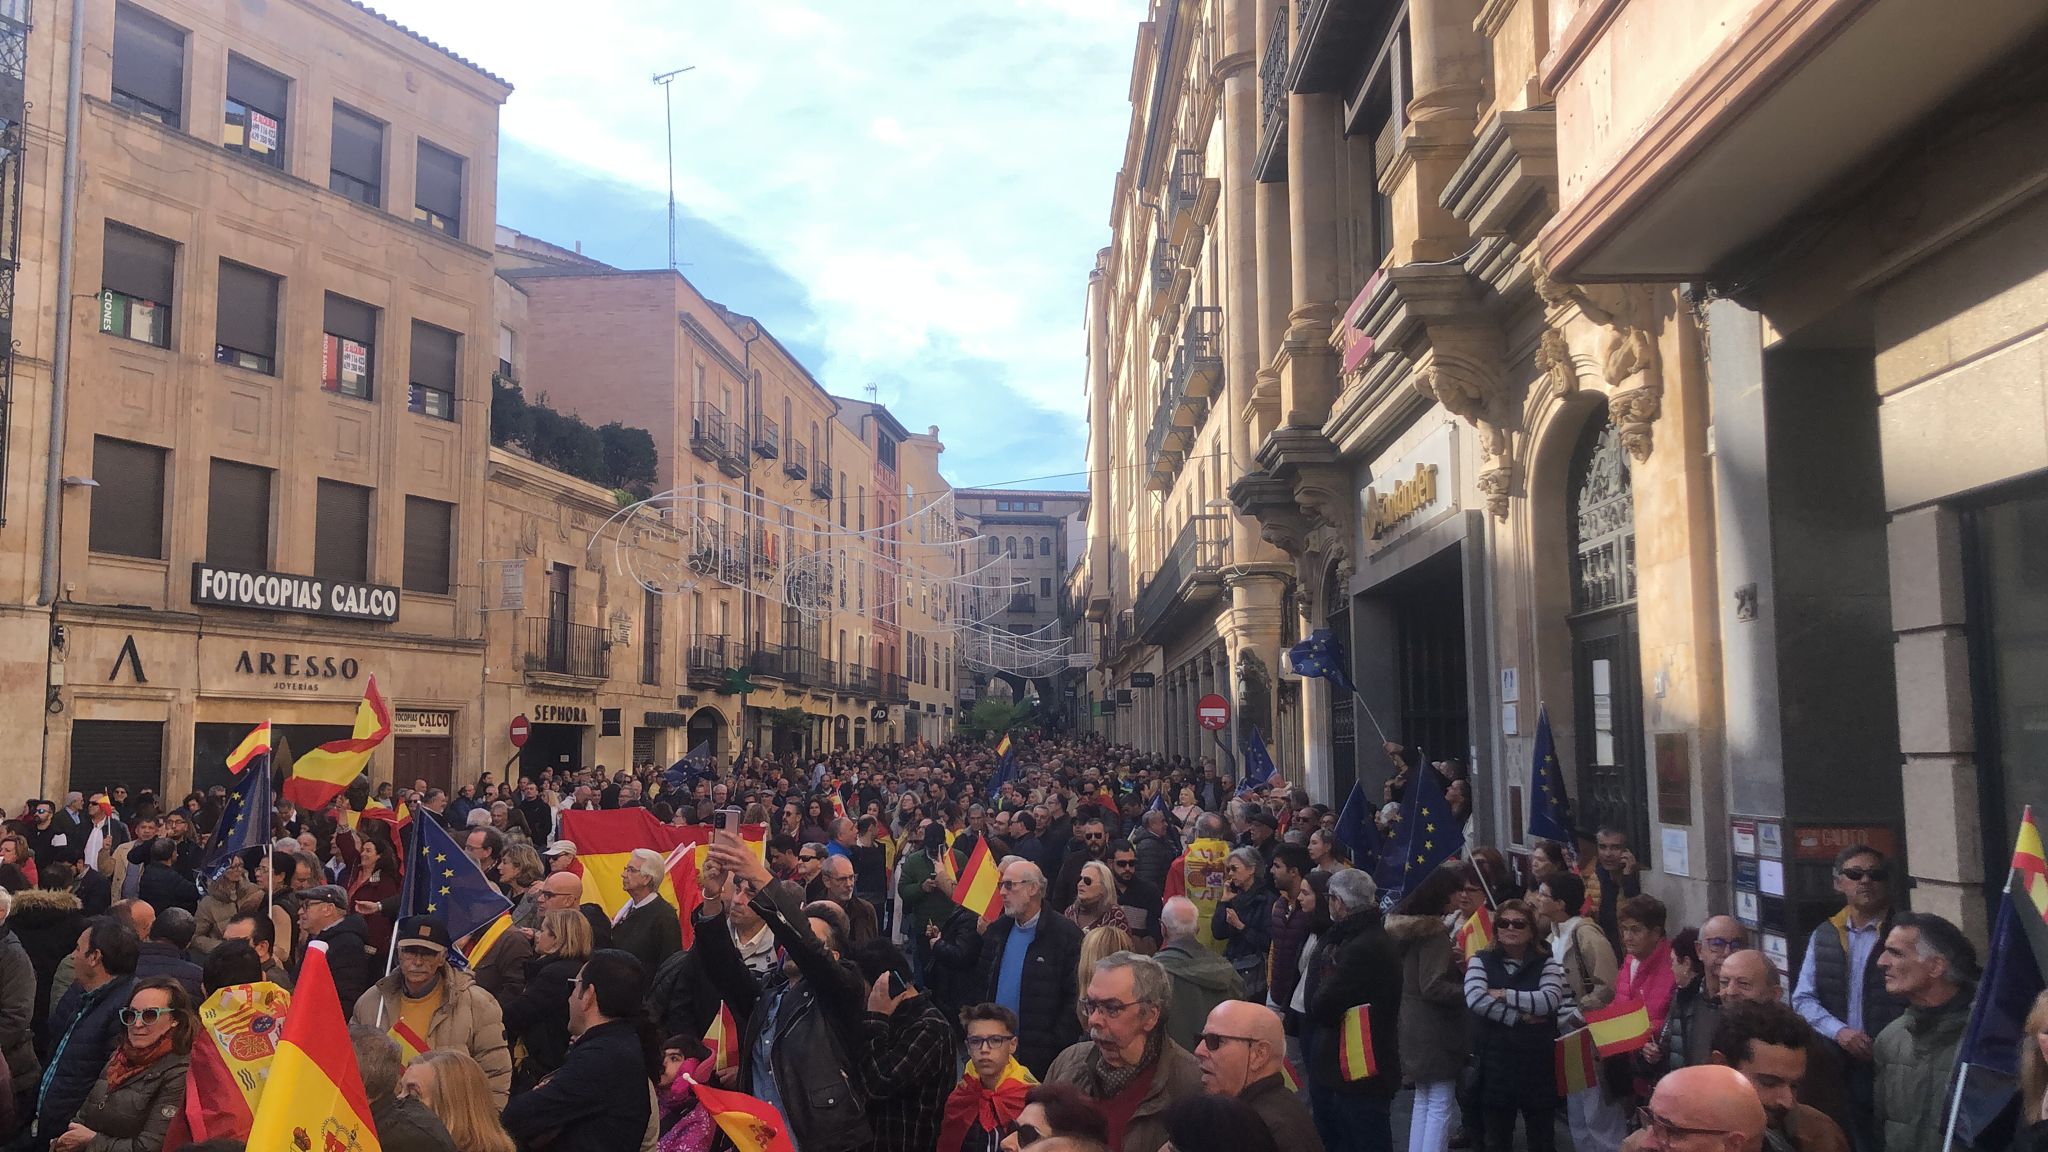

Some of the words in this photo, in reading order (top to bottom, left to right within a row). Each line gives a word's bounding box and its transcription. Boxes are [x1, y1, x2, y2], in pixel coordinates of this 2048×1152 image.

[103, 289, 113, 331] CIONES
[200, 568, 322, 610] FOTOCOPIAS
[331, 584, 397, 617] CALCO
[234, 650, 359, 680] ARESSO
[419, 714, 449, 728] CALCO
[535, 705, 587, 722] SEPHORA
